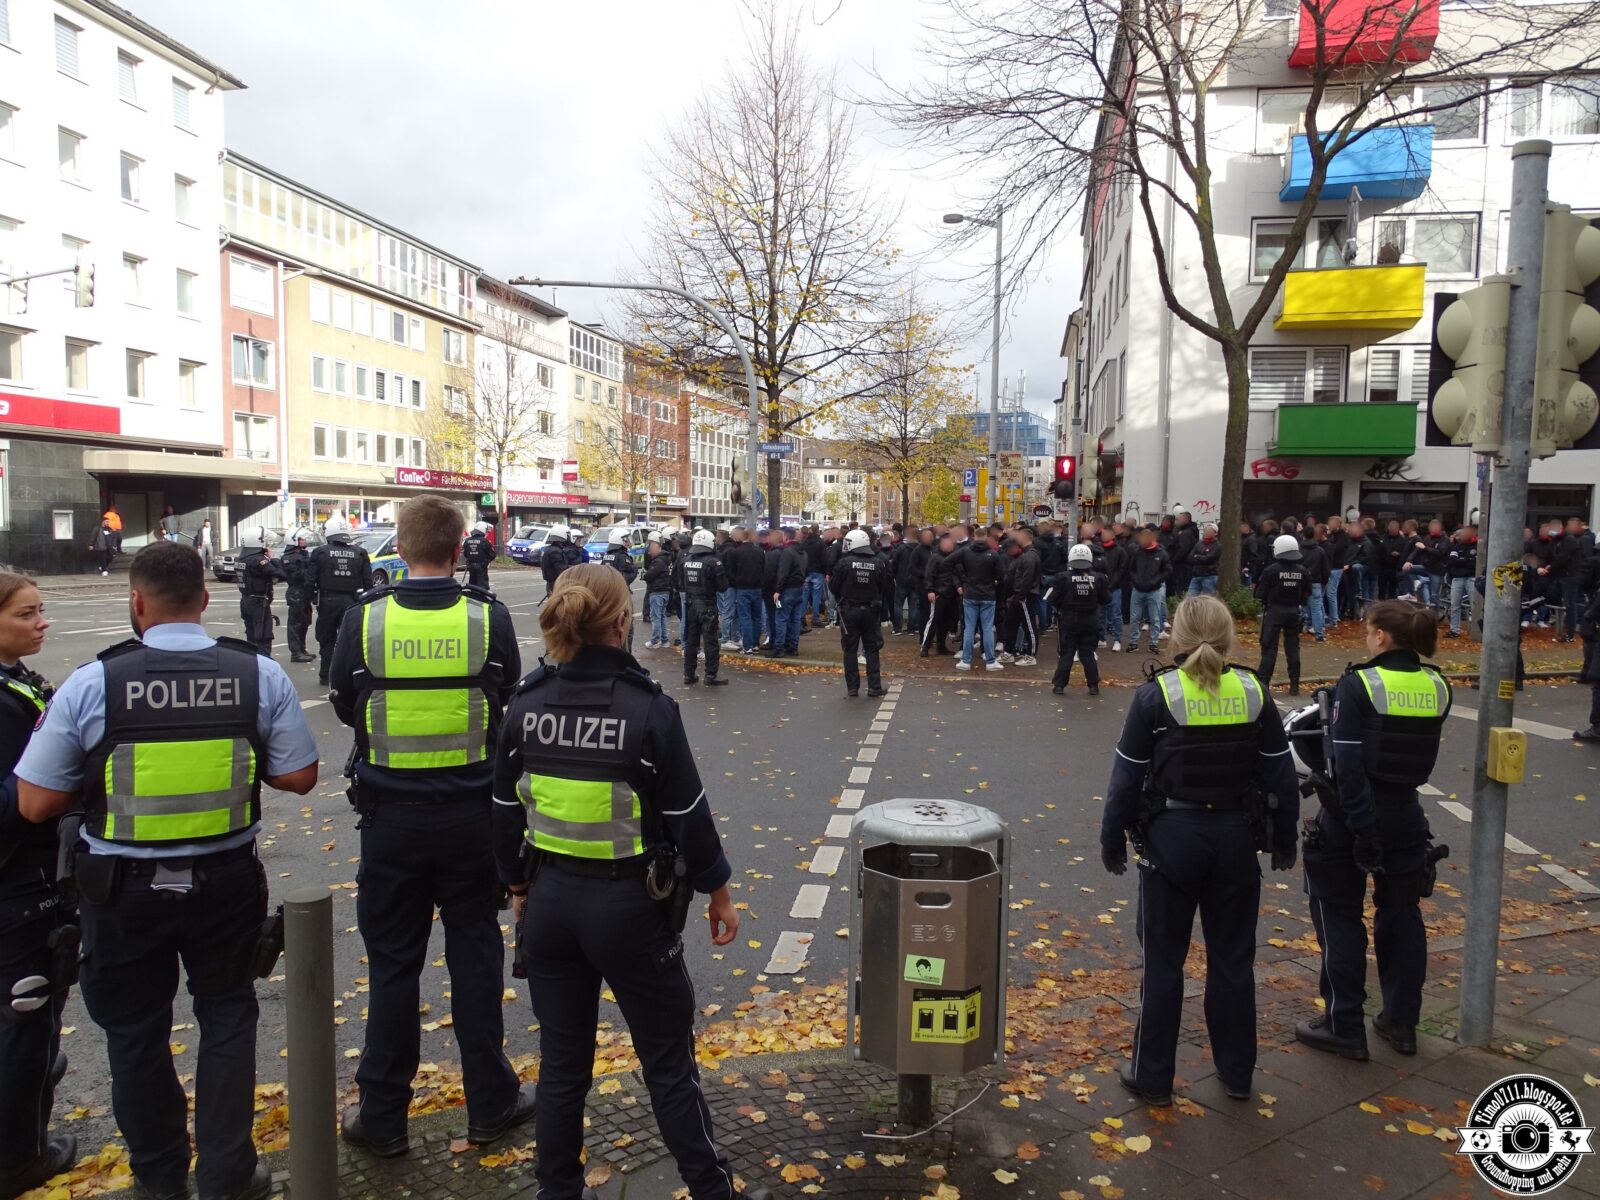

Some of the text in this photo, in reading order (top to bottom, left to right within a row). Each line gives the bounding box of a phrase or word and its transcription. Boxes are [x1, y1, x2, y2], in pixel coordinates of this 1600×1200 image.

[852, 562, 875, 570] POLIZEI
[392, 638, 461, 660] POLIZEI
[126, 678, 240, 710] POLIZEI
[1388, 690, 1435, 710] POLIZEI
[1188, 697, 1246, 717] POLIZEI
[523, 712, 626, 750] POLIZEI
[912, 924, 956, 942] EDG
